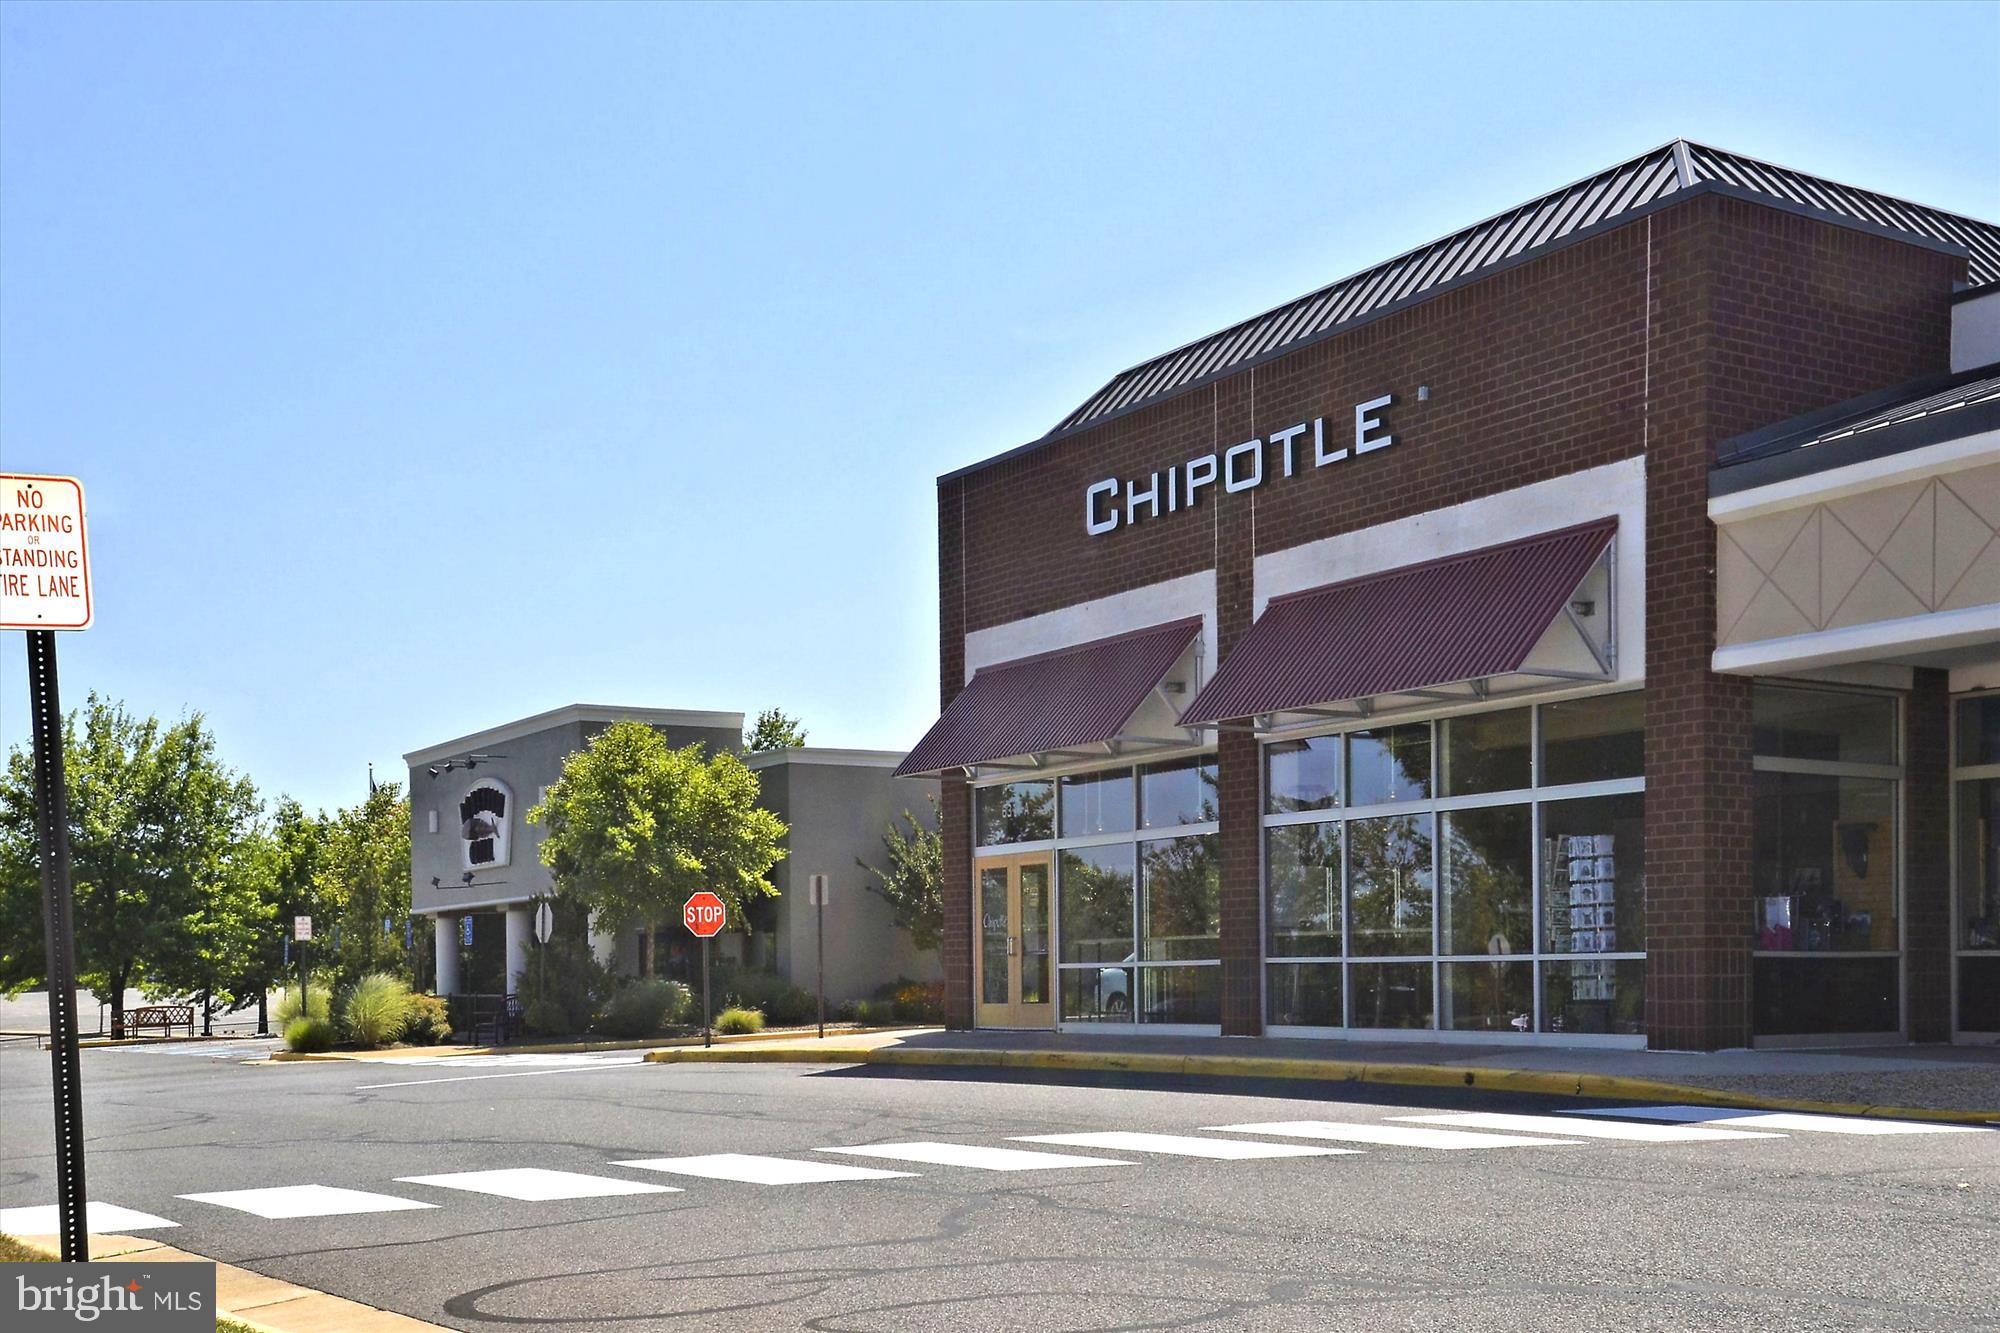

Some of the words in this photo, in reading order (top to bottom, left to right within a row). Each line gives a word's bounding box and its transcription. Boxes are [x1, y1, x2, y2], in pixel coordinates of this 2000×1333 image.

[1086, 394, 1392, 536] CHIPOTLE
[17, 490, 43, 508] NO
[28, 535, 40, 545] OR
[38, 575, 80, 597] LANE
[687, 906, 722, 922] STOP
